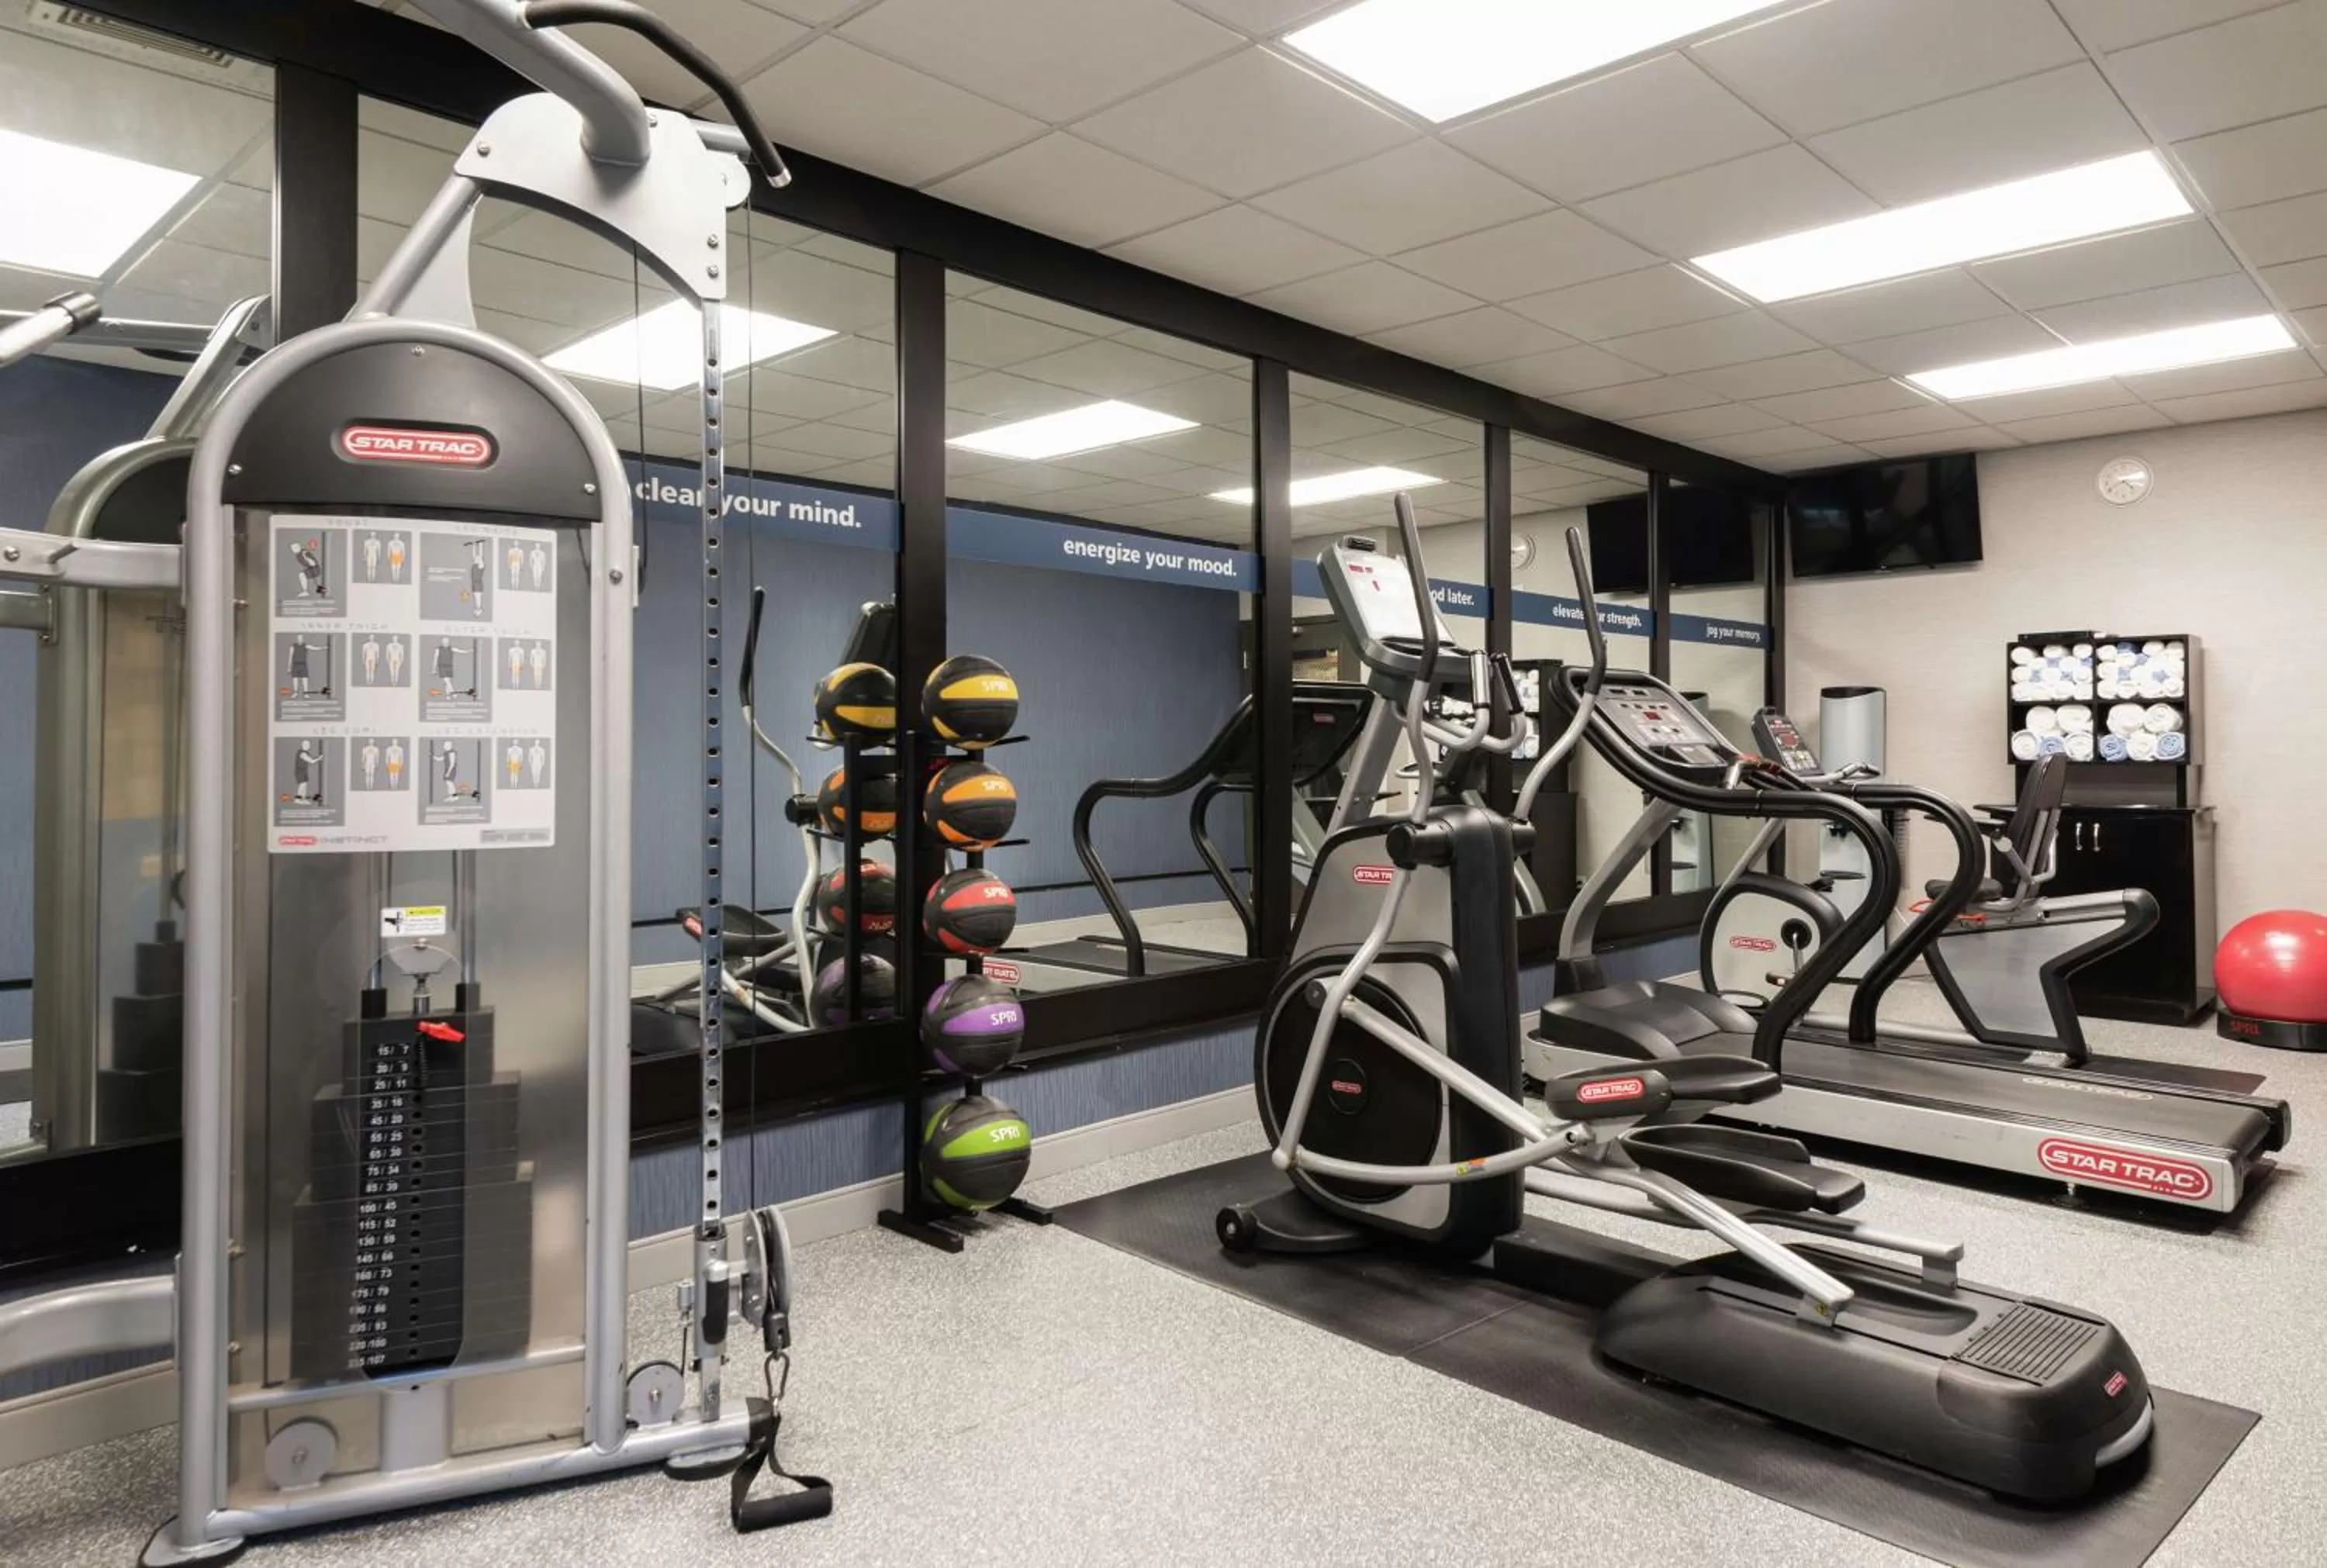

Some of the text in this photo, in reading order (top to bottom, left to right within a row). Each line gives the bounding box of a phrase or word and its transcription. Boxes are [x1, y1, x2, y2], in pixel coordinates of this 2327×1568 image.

[354, 437, 476, 454] STAR TRAC
[721, 493, 781, 517] your
[788, 500, 863, 528] mind.
[1063, 540, 1237, 577] energize your mood.
[1447, 588, 1475, 606] later.
[1552, 603, 1585, 620] elevate
[1606, 612, 1642, 629] strength.
[1357, 870, 1379, 879] STAR
[984, 887, 1008, 899] SPRI
[990, 1010, 1017, 1026] SPRI
[1584, 1083, 1637, 1096] STAR TRAC
[990, 1125, 1021, 1143] SPRI
[2050, 1149, 2195, 1188] STAR TRAC
